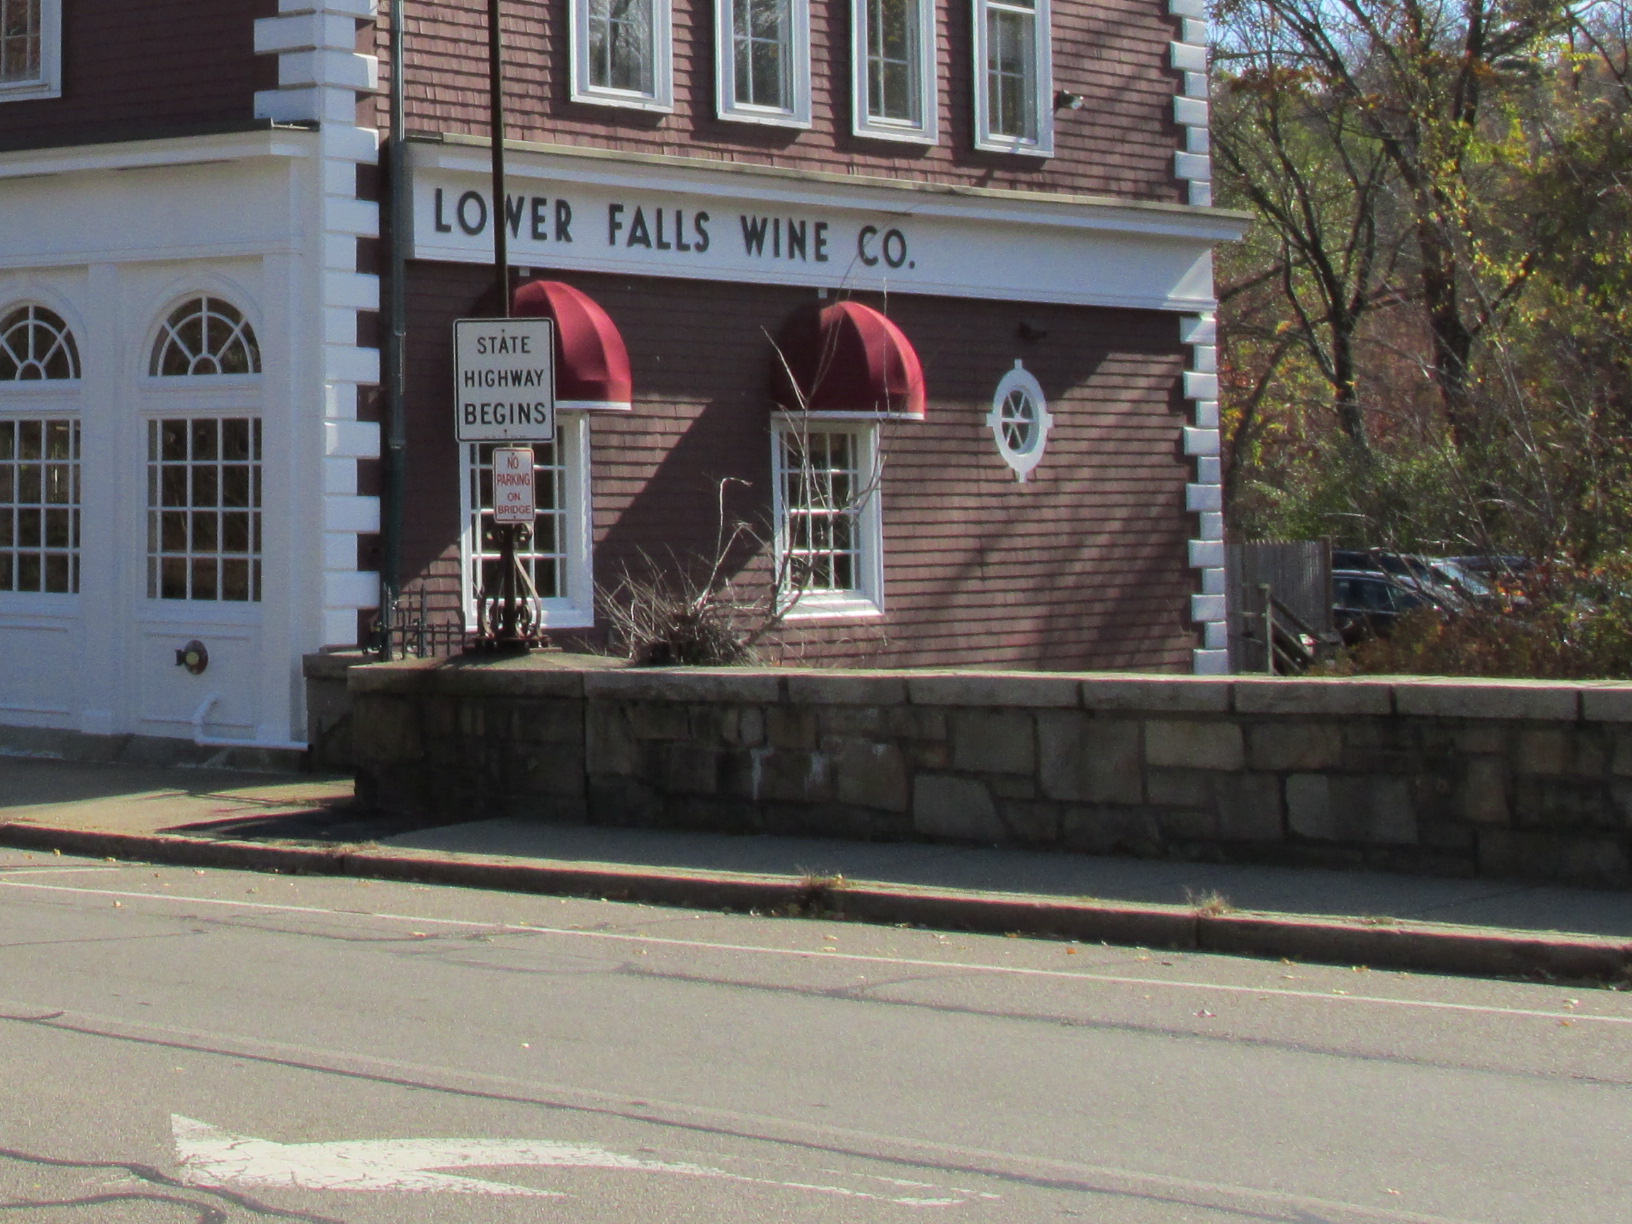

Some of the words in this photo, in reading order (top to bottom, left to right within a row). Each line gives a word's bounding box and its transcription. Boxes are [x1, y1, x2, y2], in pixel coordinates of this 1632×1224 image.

[434, 188, 573, 243] LOWER
[609, 203, 710, 252] FALLS
[740, 214, 829, 262] WINE
[858, 225, 916, 270] CO.
[477, 336, 531, 354] STATE
[464, 369, 544, 387] HIGHWAY
[464, 402, 546, 425] BEGINS
[507, 457, 519, 469] NO
[496, 473, 531, 486] PARKING
[507, 492, 521, 501] ON
[497, 505, 531, 514] BRIDGE
